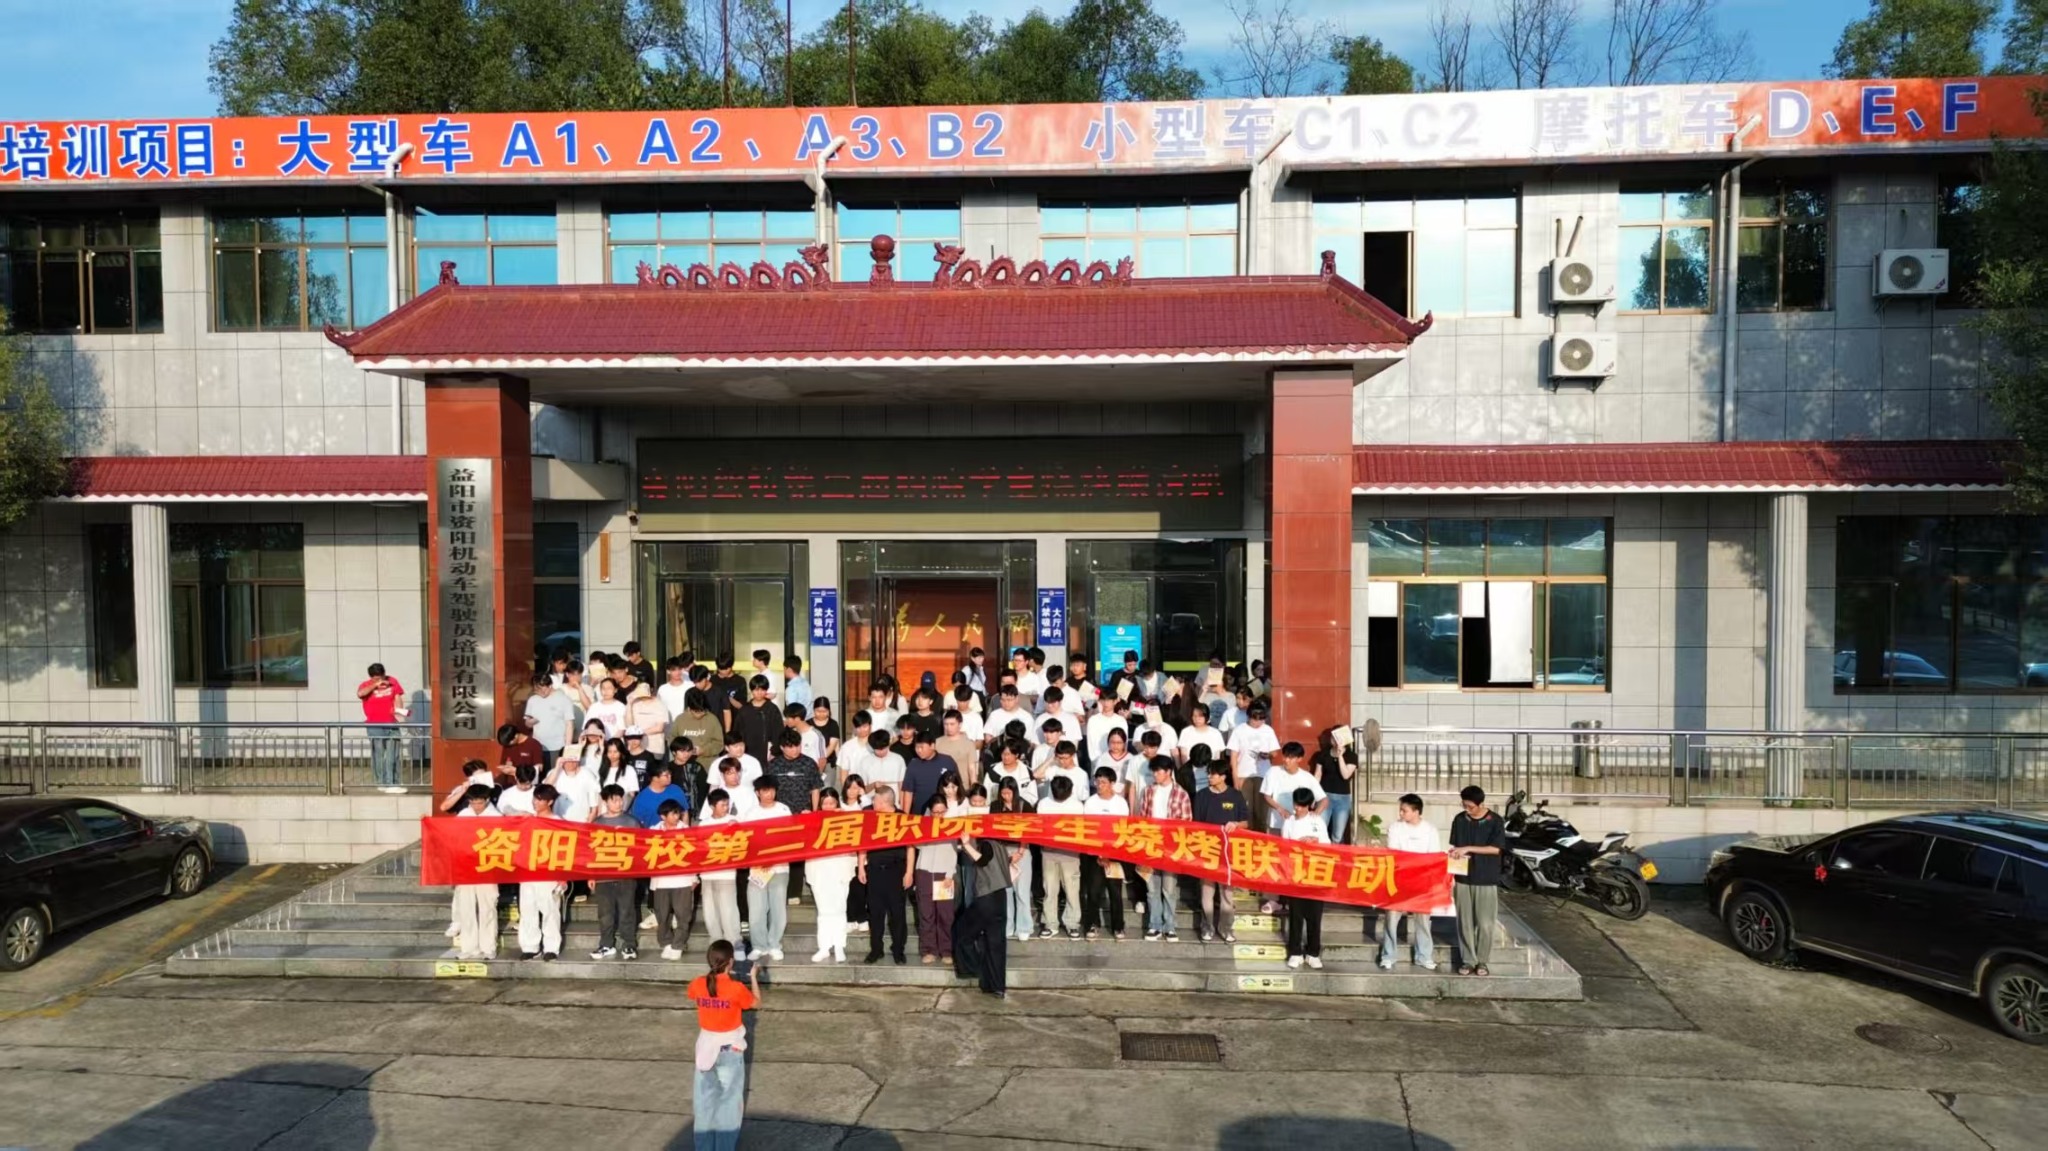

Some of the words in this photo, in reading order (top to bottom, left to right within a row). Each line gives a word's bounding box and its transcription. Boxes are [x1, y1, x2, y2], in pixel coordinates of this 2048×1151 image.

[449, 468, 478, 730] 益阳市资阳机动车驾驶员培训有限公司
[472, 811, 1398, 897] 资阳驾校第二届职院学生烧烤联谊趴
